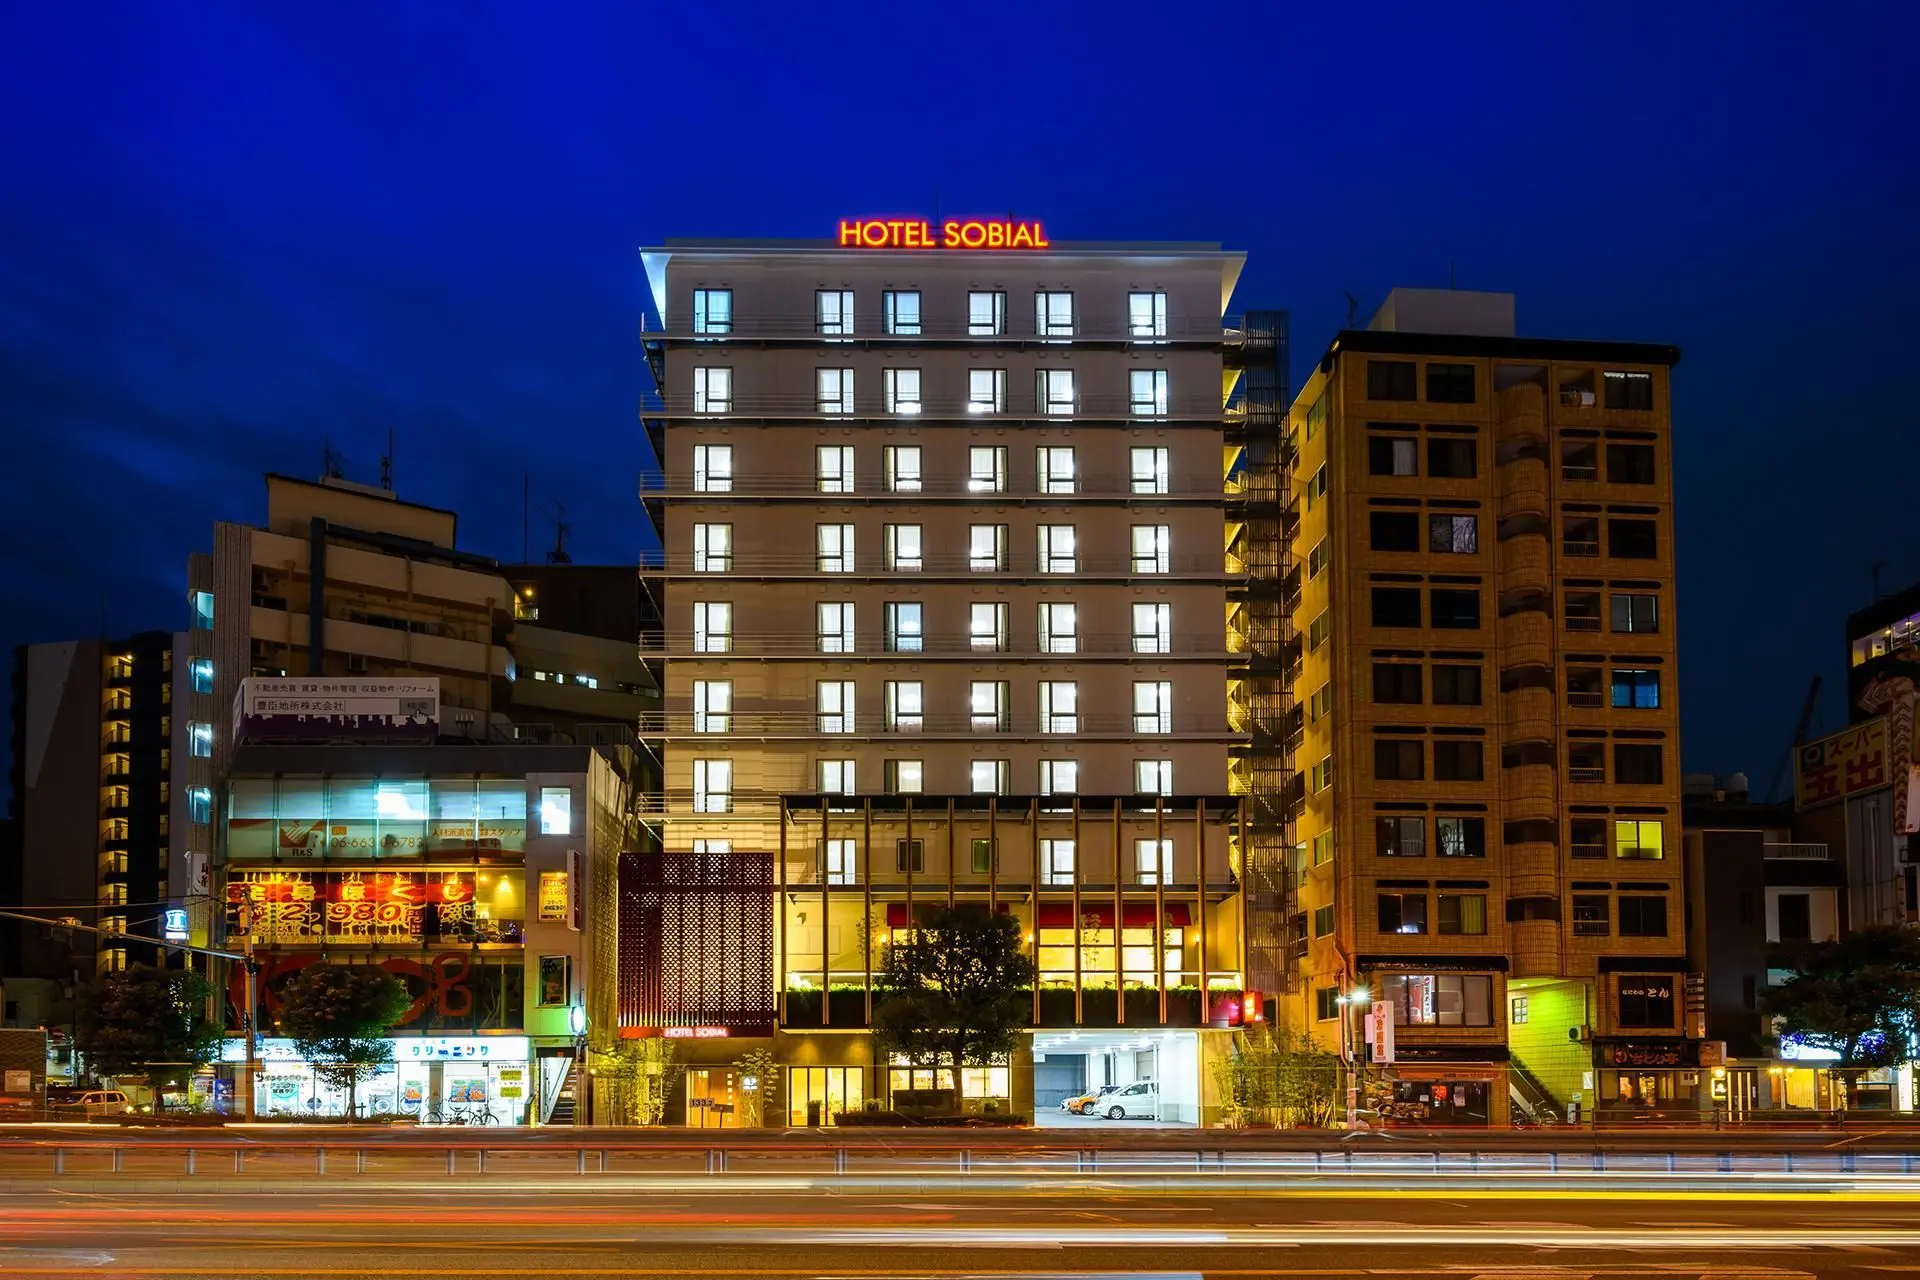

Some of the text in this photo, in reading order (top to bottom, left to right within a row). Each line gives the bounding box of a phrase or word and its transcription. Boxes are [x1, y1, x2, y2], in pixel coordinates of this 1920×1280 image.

[841, 221, 1048, 247] HOTEL SOBIAL
[257, 701, 344, 711] 豊臣地所株式会社
[1829, 727, 1882, 758] スーパー
[1801, 749, 1884, 805] 玉出
[665, 1027, 728, 1038] HOTEL SOBIAL
